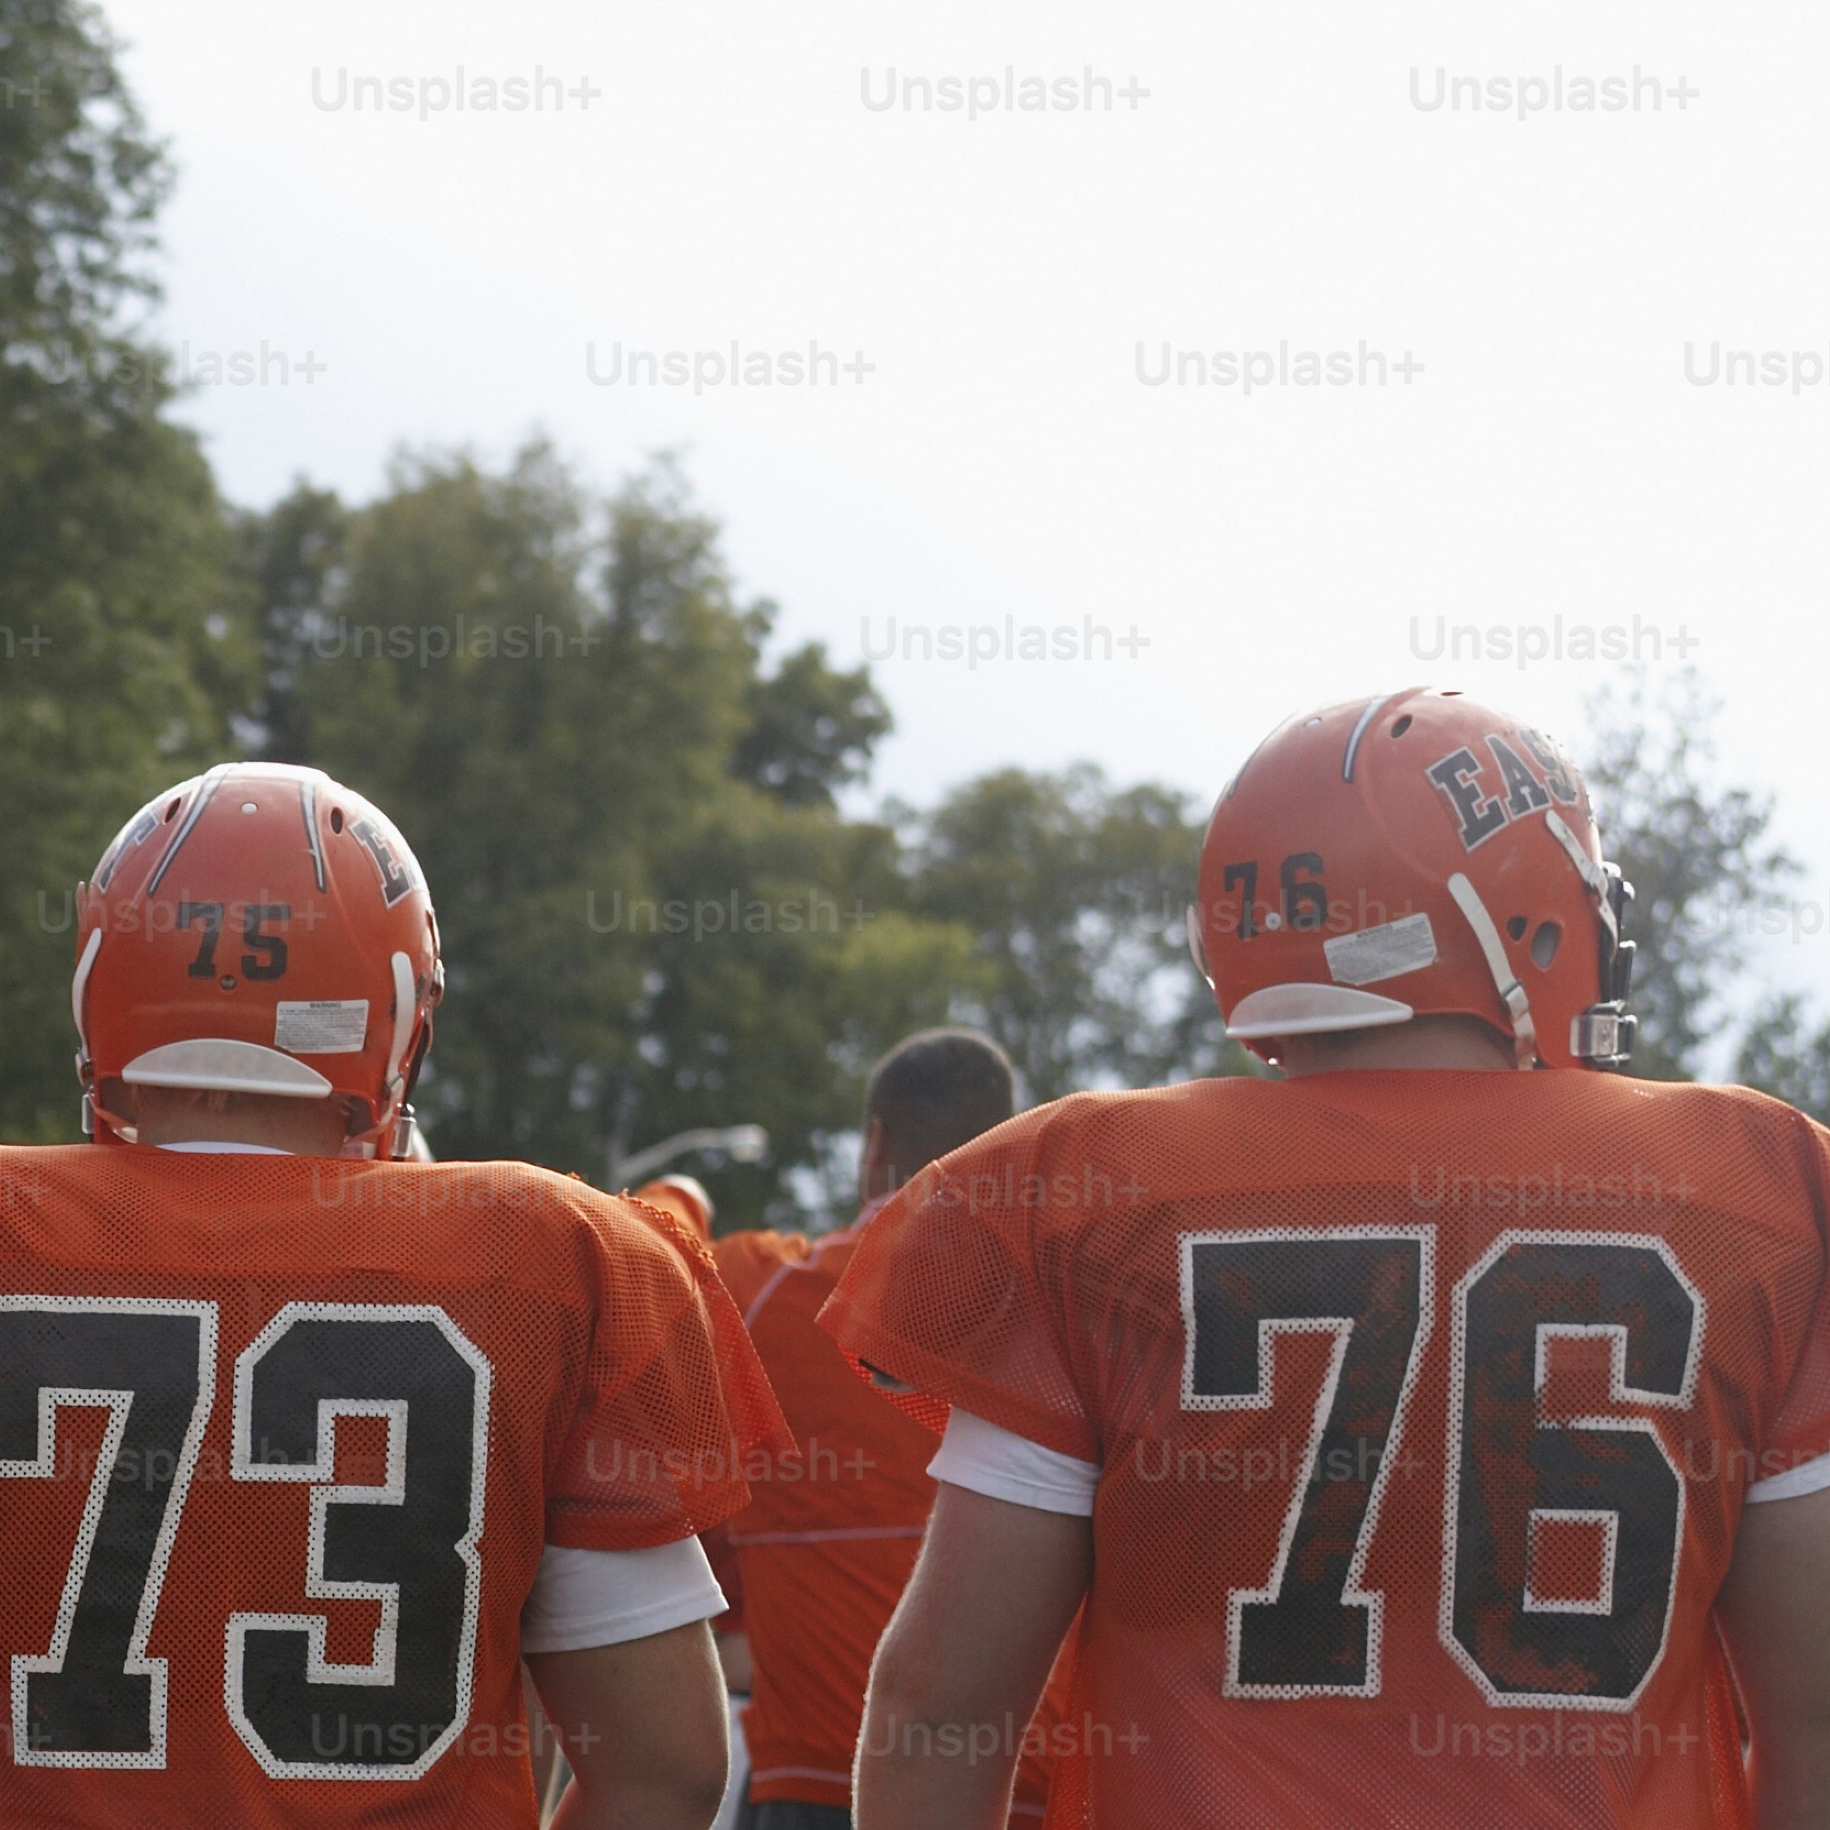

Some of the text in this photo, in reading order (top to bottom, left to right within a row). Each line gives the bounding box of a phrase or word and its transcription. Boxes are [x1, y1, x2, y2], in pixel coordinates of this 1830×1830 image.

[1223, 851, 1329, 940] 76
[176, 901, 291, 981] 75
[1177, 1225, 1707, 1711] 76
